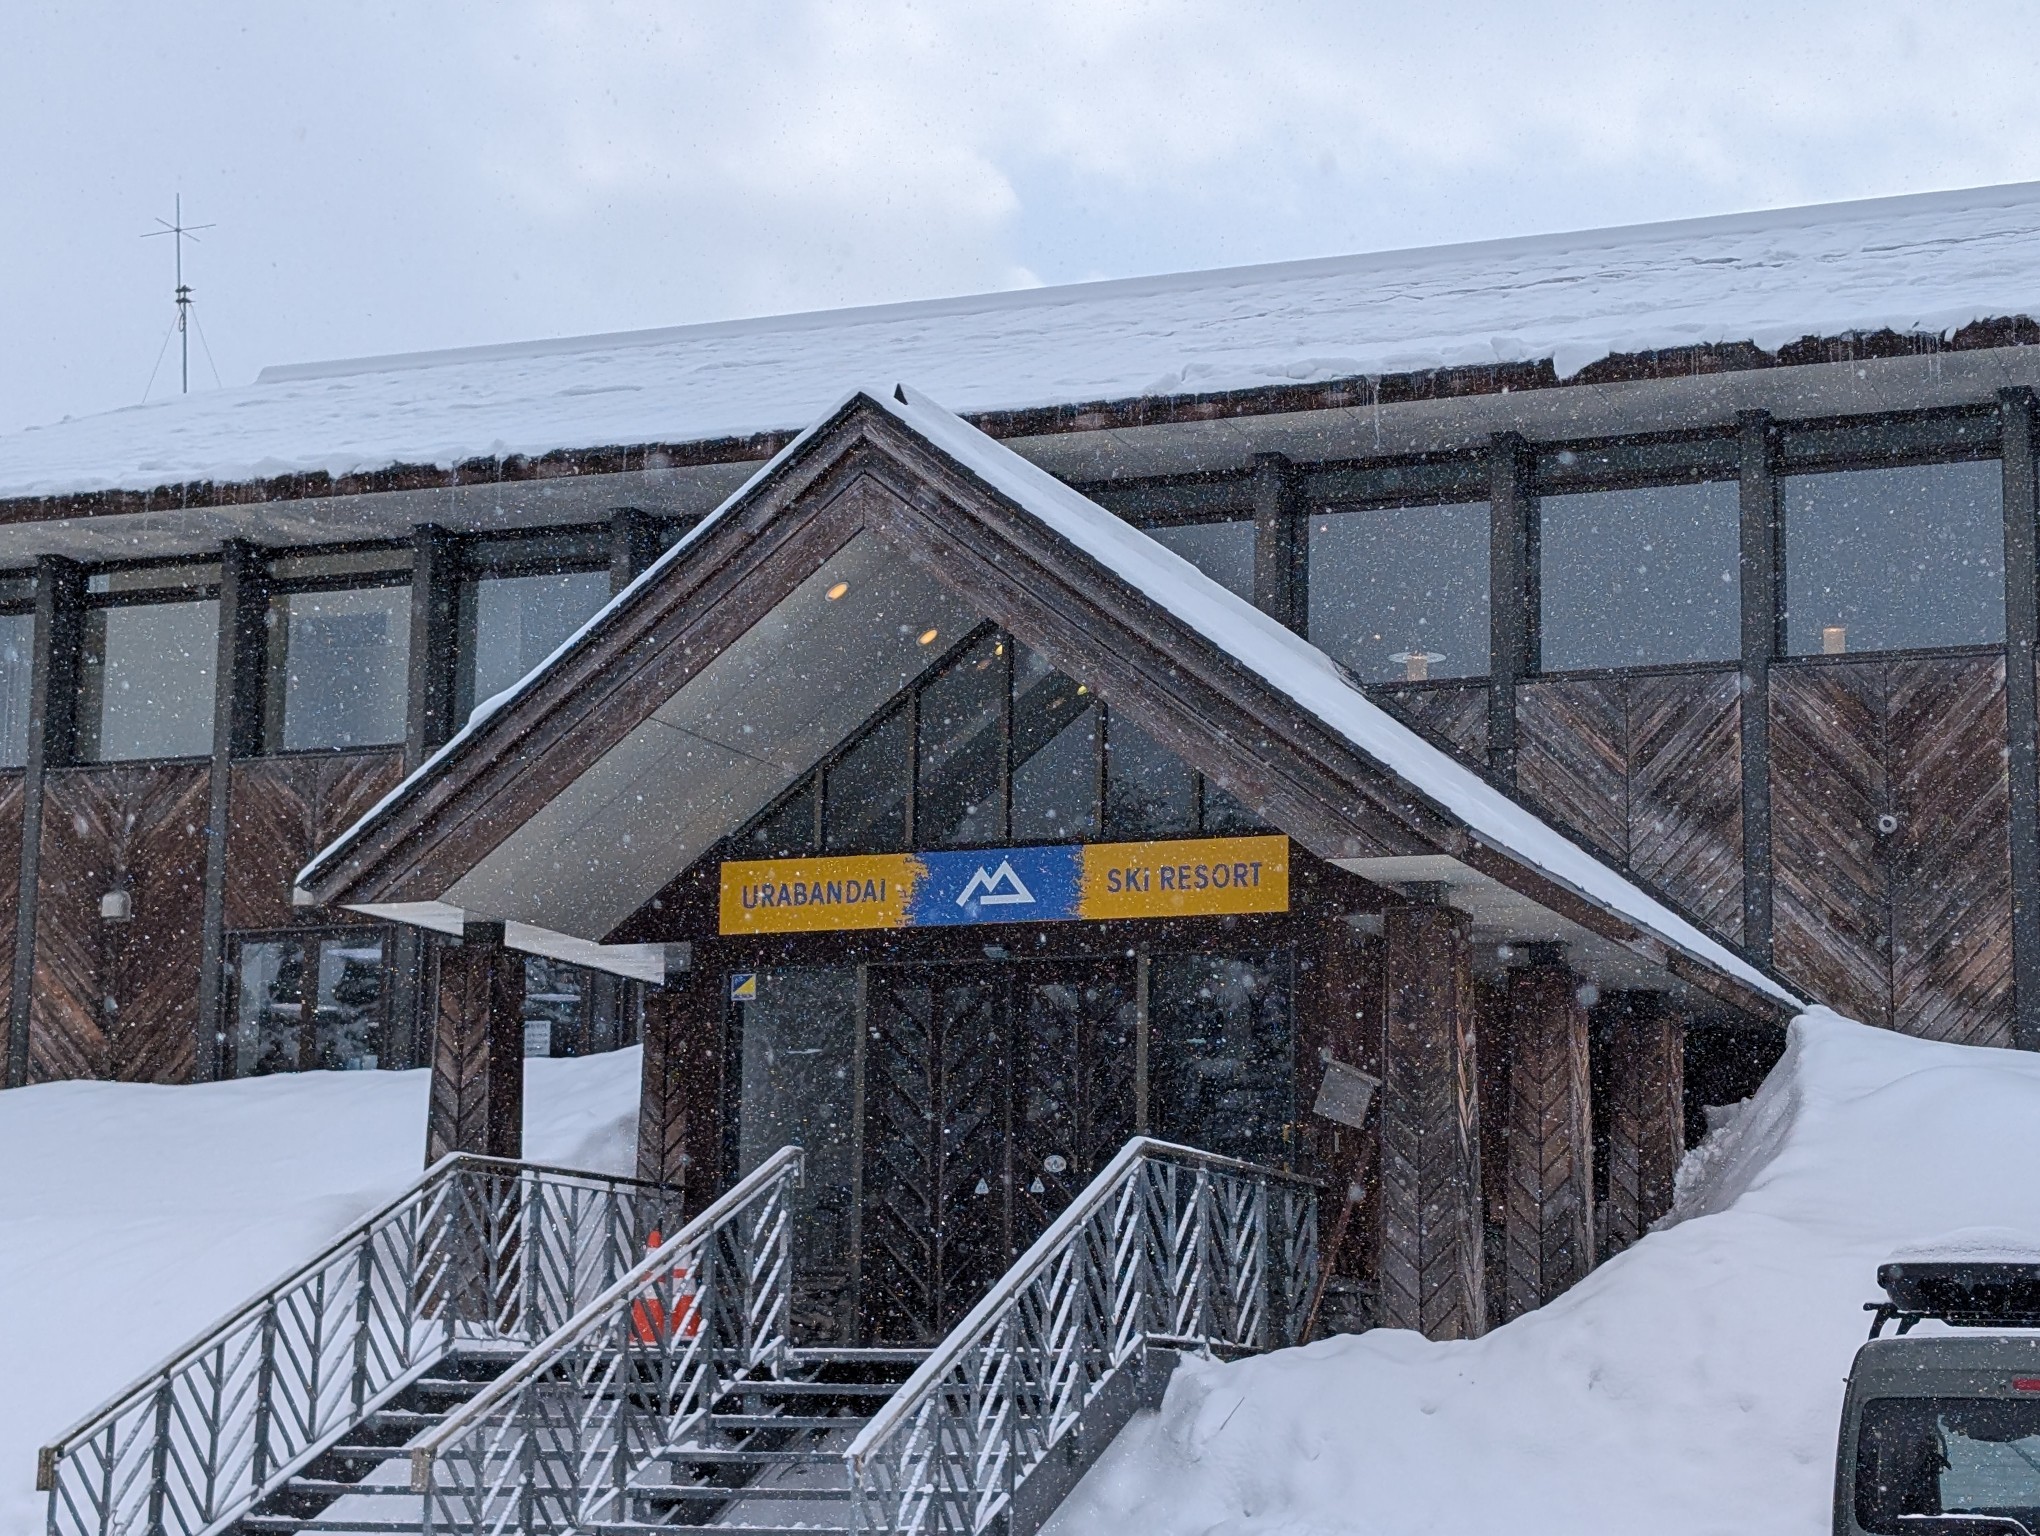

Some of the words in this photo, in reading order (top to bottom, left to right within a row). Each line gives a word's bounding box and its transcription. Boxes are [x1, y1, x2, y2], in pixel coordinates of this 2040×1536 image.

[742, 878, 886, 909] URABANDAI
[1107, 867, 1149, 893] SKI
[1160, 861, 1263, 891] RESORT
